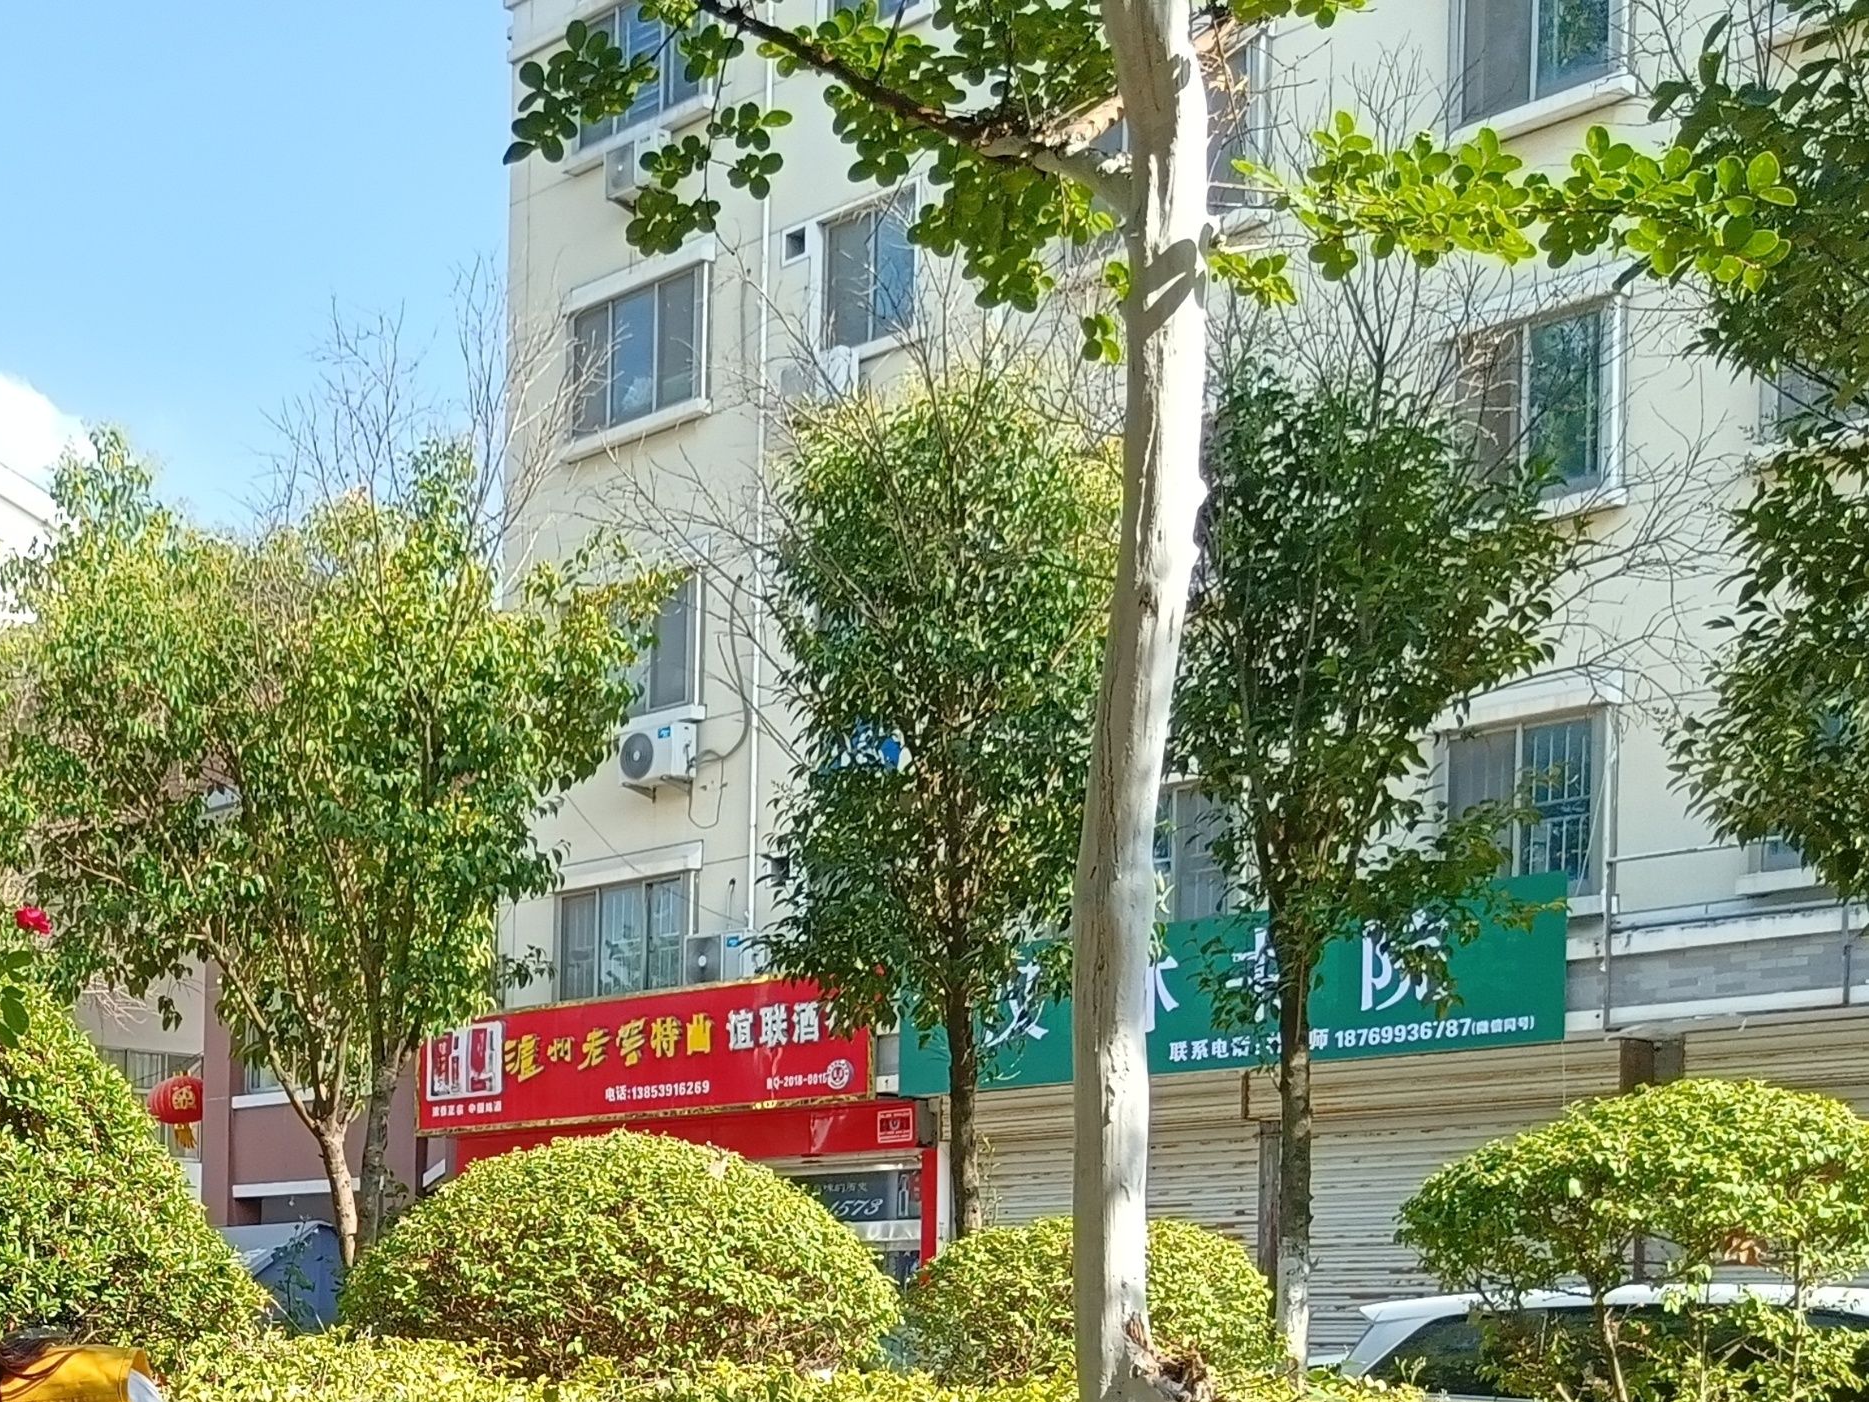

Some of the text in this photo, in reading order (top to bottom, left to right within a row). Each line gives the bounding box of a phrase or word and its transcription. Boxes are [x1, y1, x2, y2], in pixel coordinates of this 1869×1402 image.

[504, 1013, 712, 1083] 泸州老窖特曲
[726, 1001, 838, 1050] 谊联酒
[605, 1079, 710, 1102] 电话:13853916269
